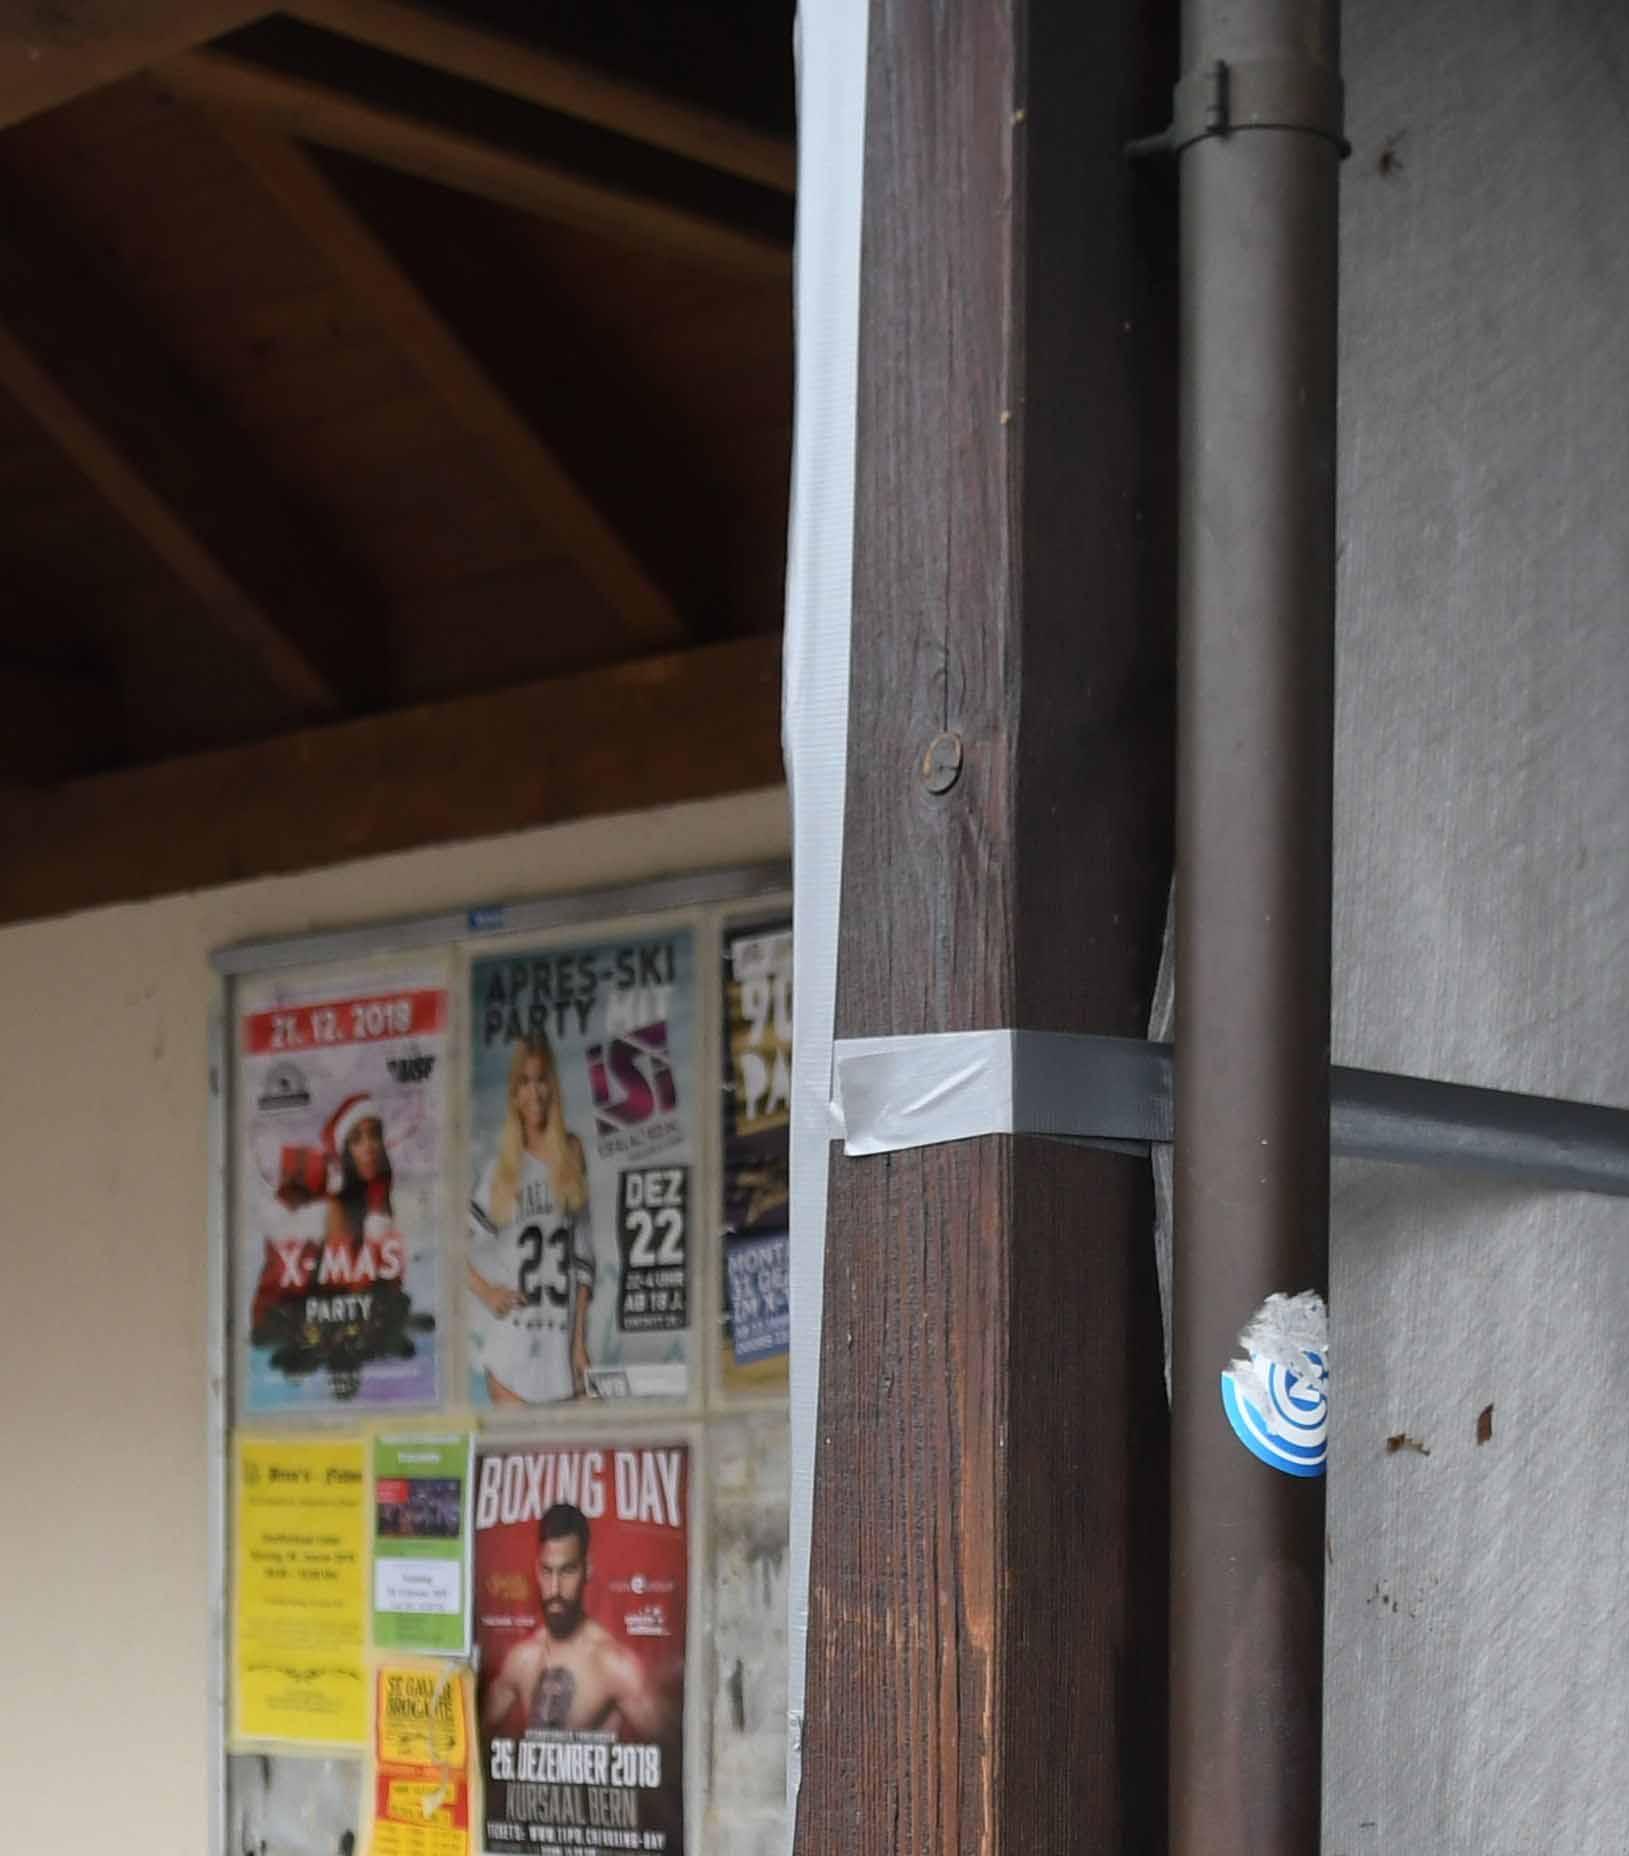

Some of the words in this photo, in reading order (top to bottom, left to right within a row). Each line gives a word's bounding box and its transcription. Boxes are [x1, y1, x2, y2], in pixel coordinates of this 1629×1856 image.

[484, 998, 596, 1047] PARTY
[624, 1169, 684, 1209] DEZ
[624, 1208, 684, 1269] 22
[279, 1239, 402, 1289] X-MAS
[517, 1225, 572, 1307] 23
[306, 1296, 374, 1323] PARTY
[477, 1449, 606, 1531] BOXING
[614, 1451, 681, 1528] DAY
[490, 1738, 515, 1781] 26.
[517, 1739, 610, 1785] DEZEMBER
[611, 1742, 663, 1788] 2018
[505, 1782, 586, 1825] KURSAAL
[587, 1785, 639, 1827] BERN
